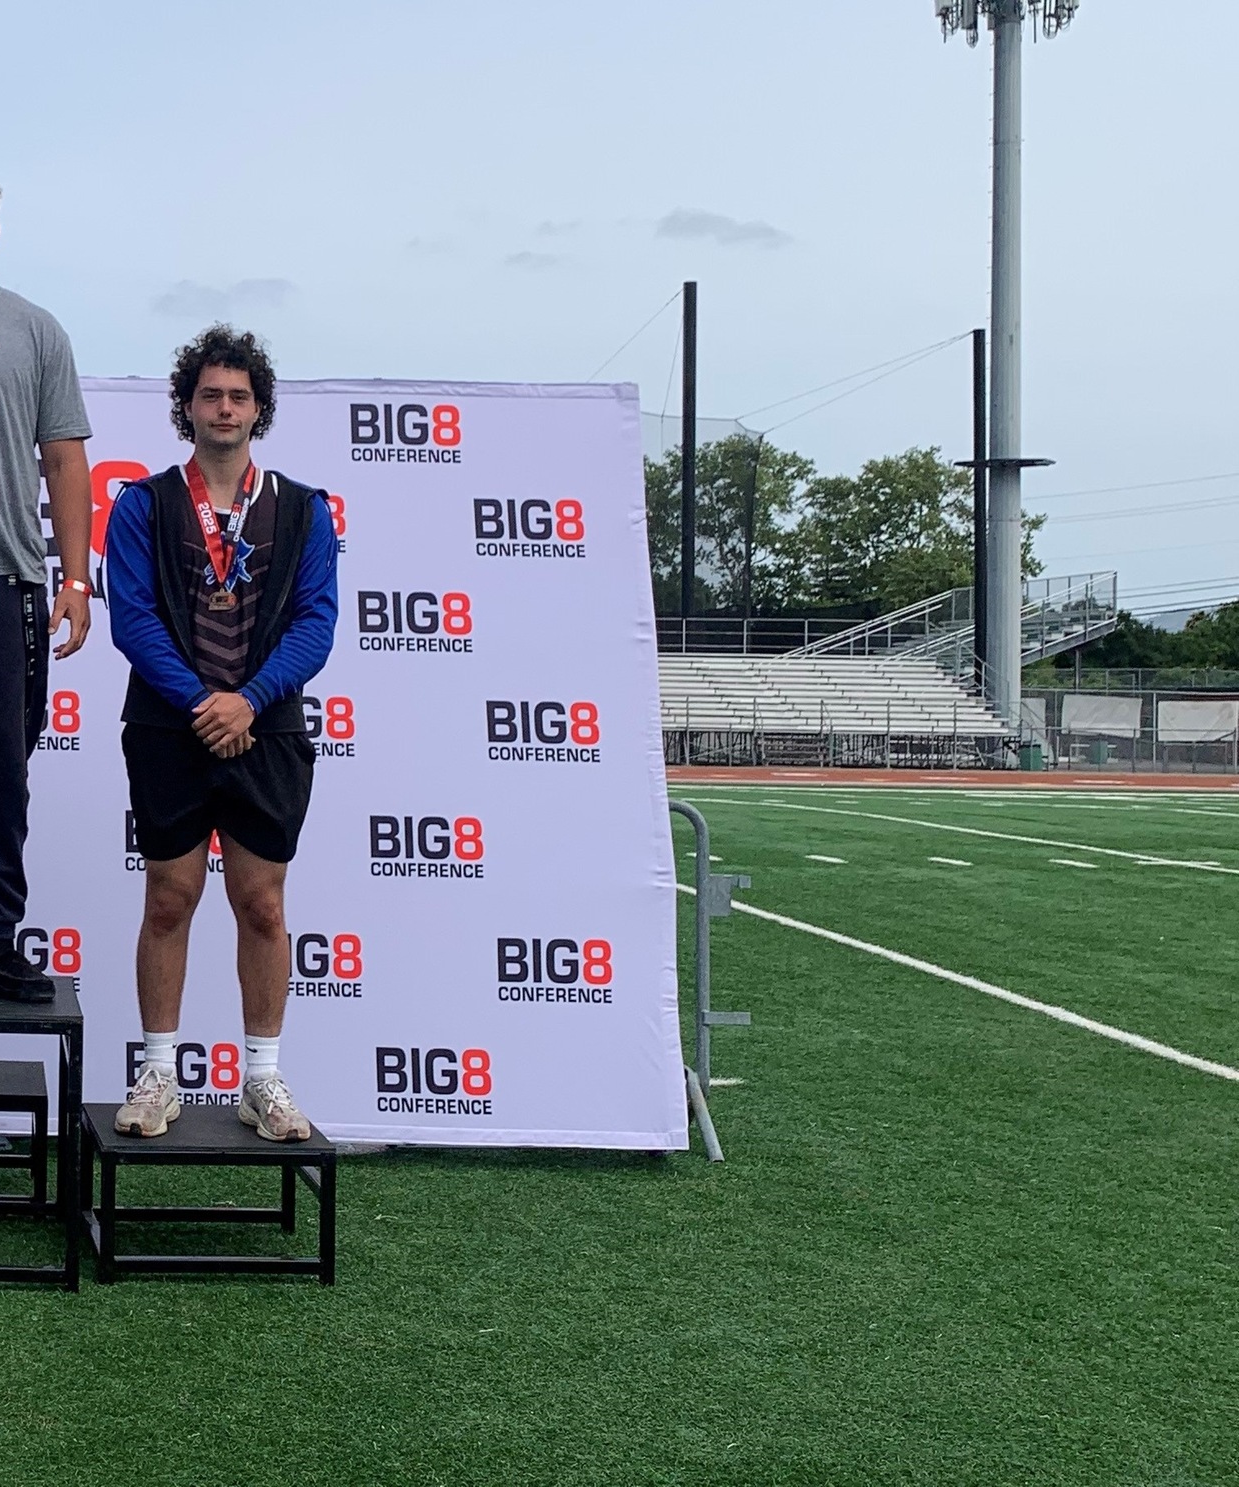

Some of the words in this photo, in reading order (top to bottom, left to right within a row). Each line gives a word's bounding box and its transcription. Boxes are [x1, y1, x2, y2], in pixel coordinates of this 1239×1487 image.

[349, 403, 462, 447] BIG8
[351, 448, 462, 463] CONFERENCE
[198, 501, 218, 535] 2025
[227, 503, 242, 532] BIG8
[473, 498, 585, 541] BIG8
[476, 543, 586, 558] CONFERENCE
[358, 590, 473, 636] BIG8
[360, 637, 473, 653] CONFERENCE
[486, 700, 601, 745] BIG8
[488, 747, 601, 763] CONFERENCE
[369, 815, 485, 861] BIG8
[371, 862, 484, 879] CONFERENCE
[497, 937, 613, 985] BIG8
[287, 981, 363, 998] FERENCE
[499, 986, 613, 1004] CONFERENCE
[376, 1046, 493, 1096] BIG8
[377, 1098, 493, 1115] CONFERENCE
